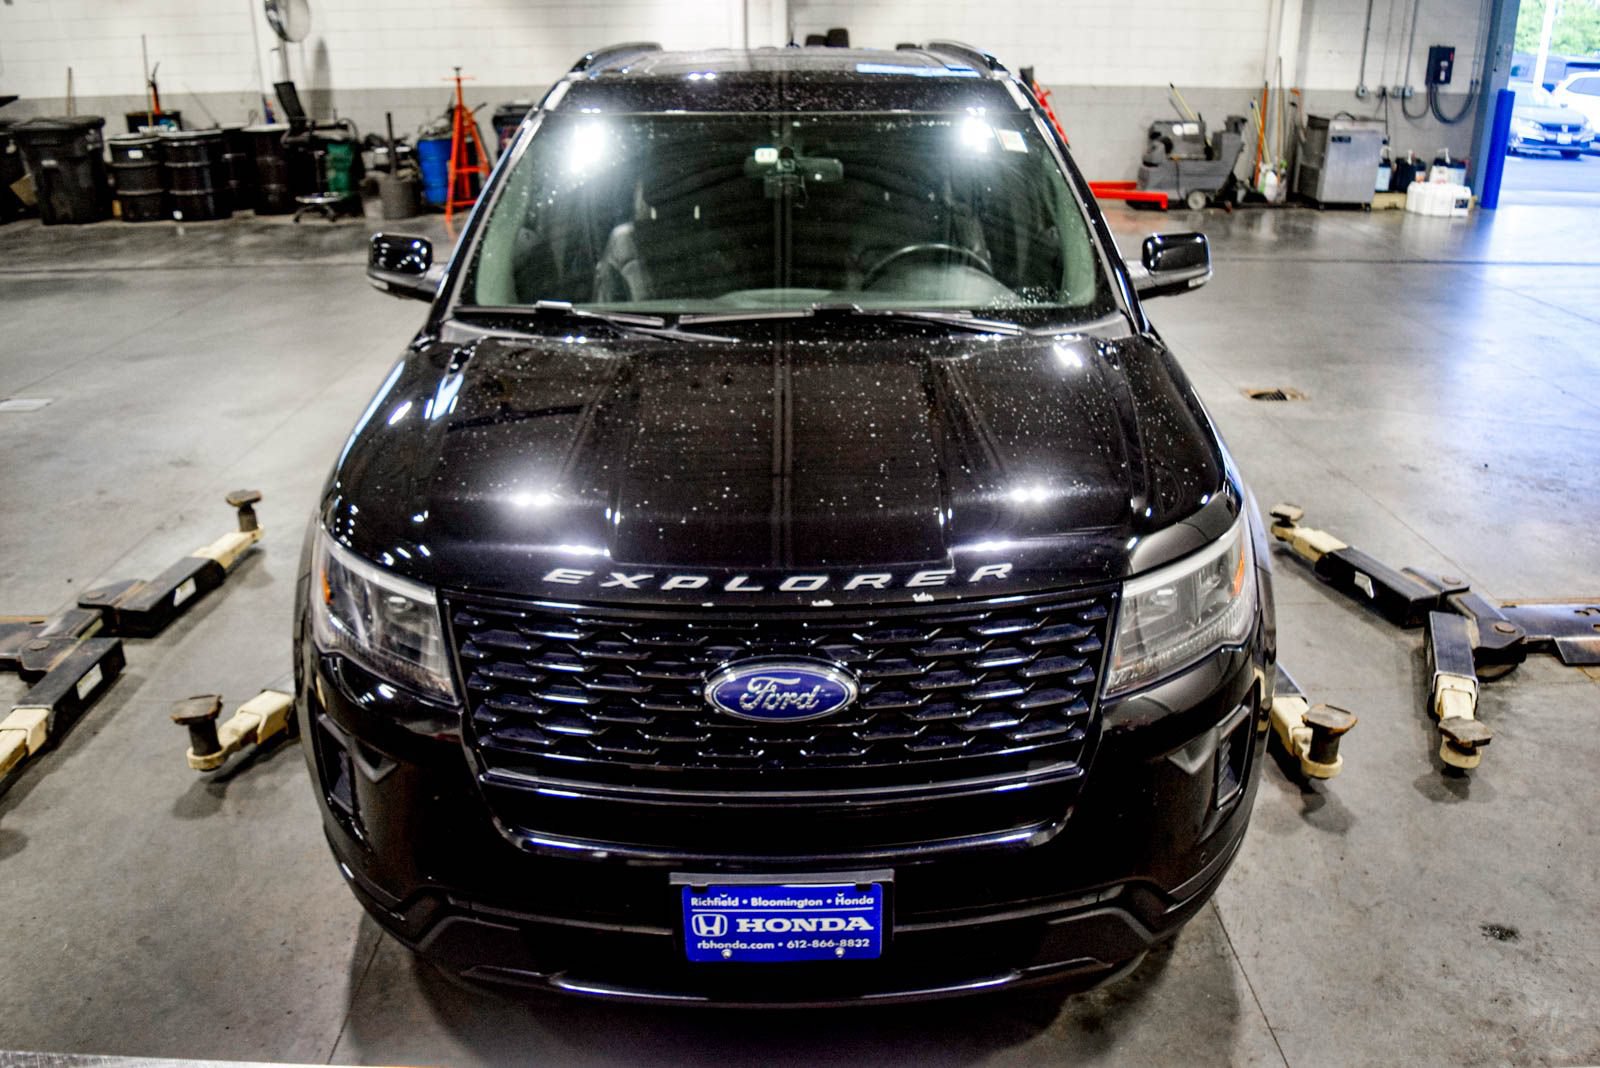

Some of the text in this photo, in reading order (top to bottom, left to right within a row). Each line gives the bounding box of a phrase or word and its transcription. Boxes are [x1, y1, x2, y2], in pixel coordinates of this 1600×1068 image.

[542, 563, 1014, 592] EXPLORER
[739, 676, 822, 711] Ford
[690, 895, 875, 909] Richfield Bloomington Honda
[736, 916, 874, 933] HONDA
[697, 939, 775, 950] rbhonda.com
